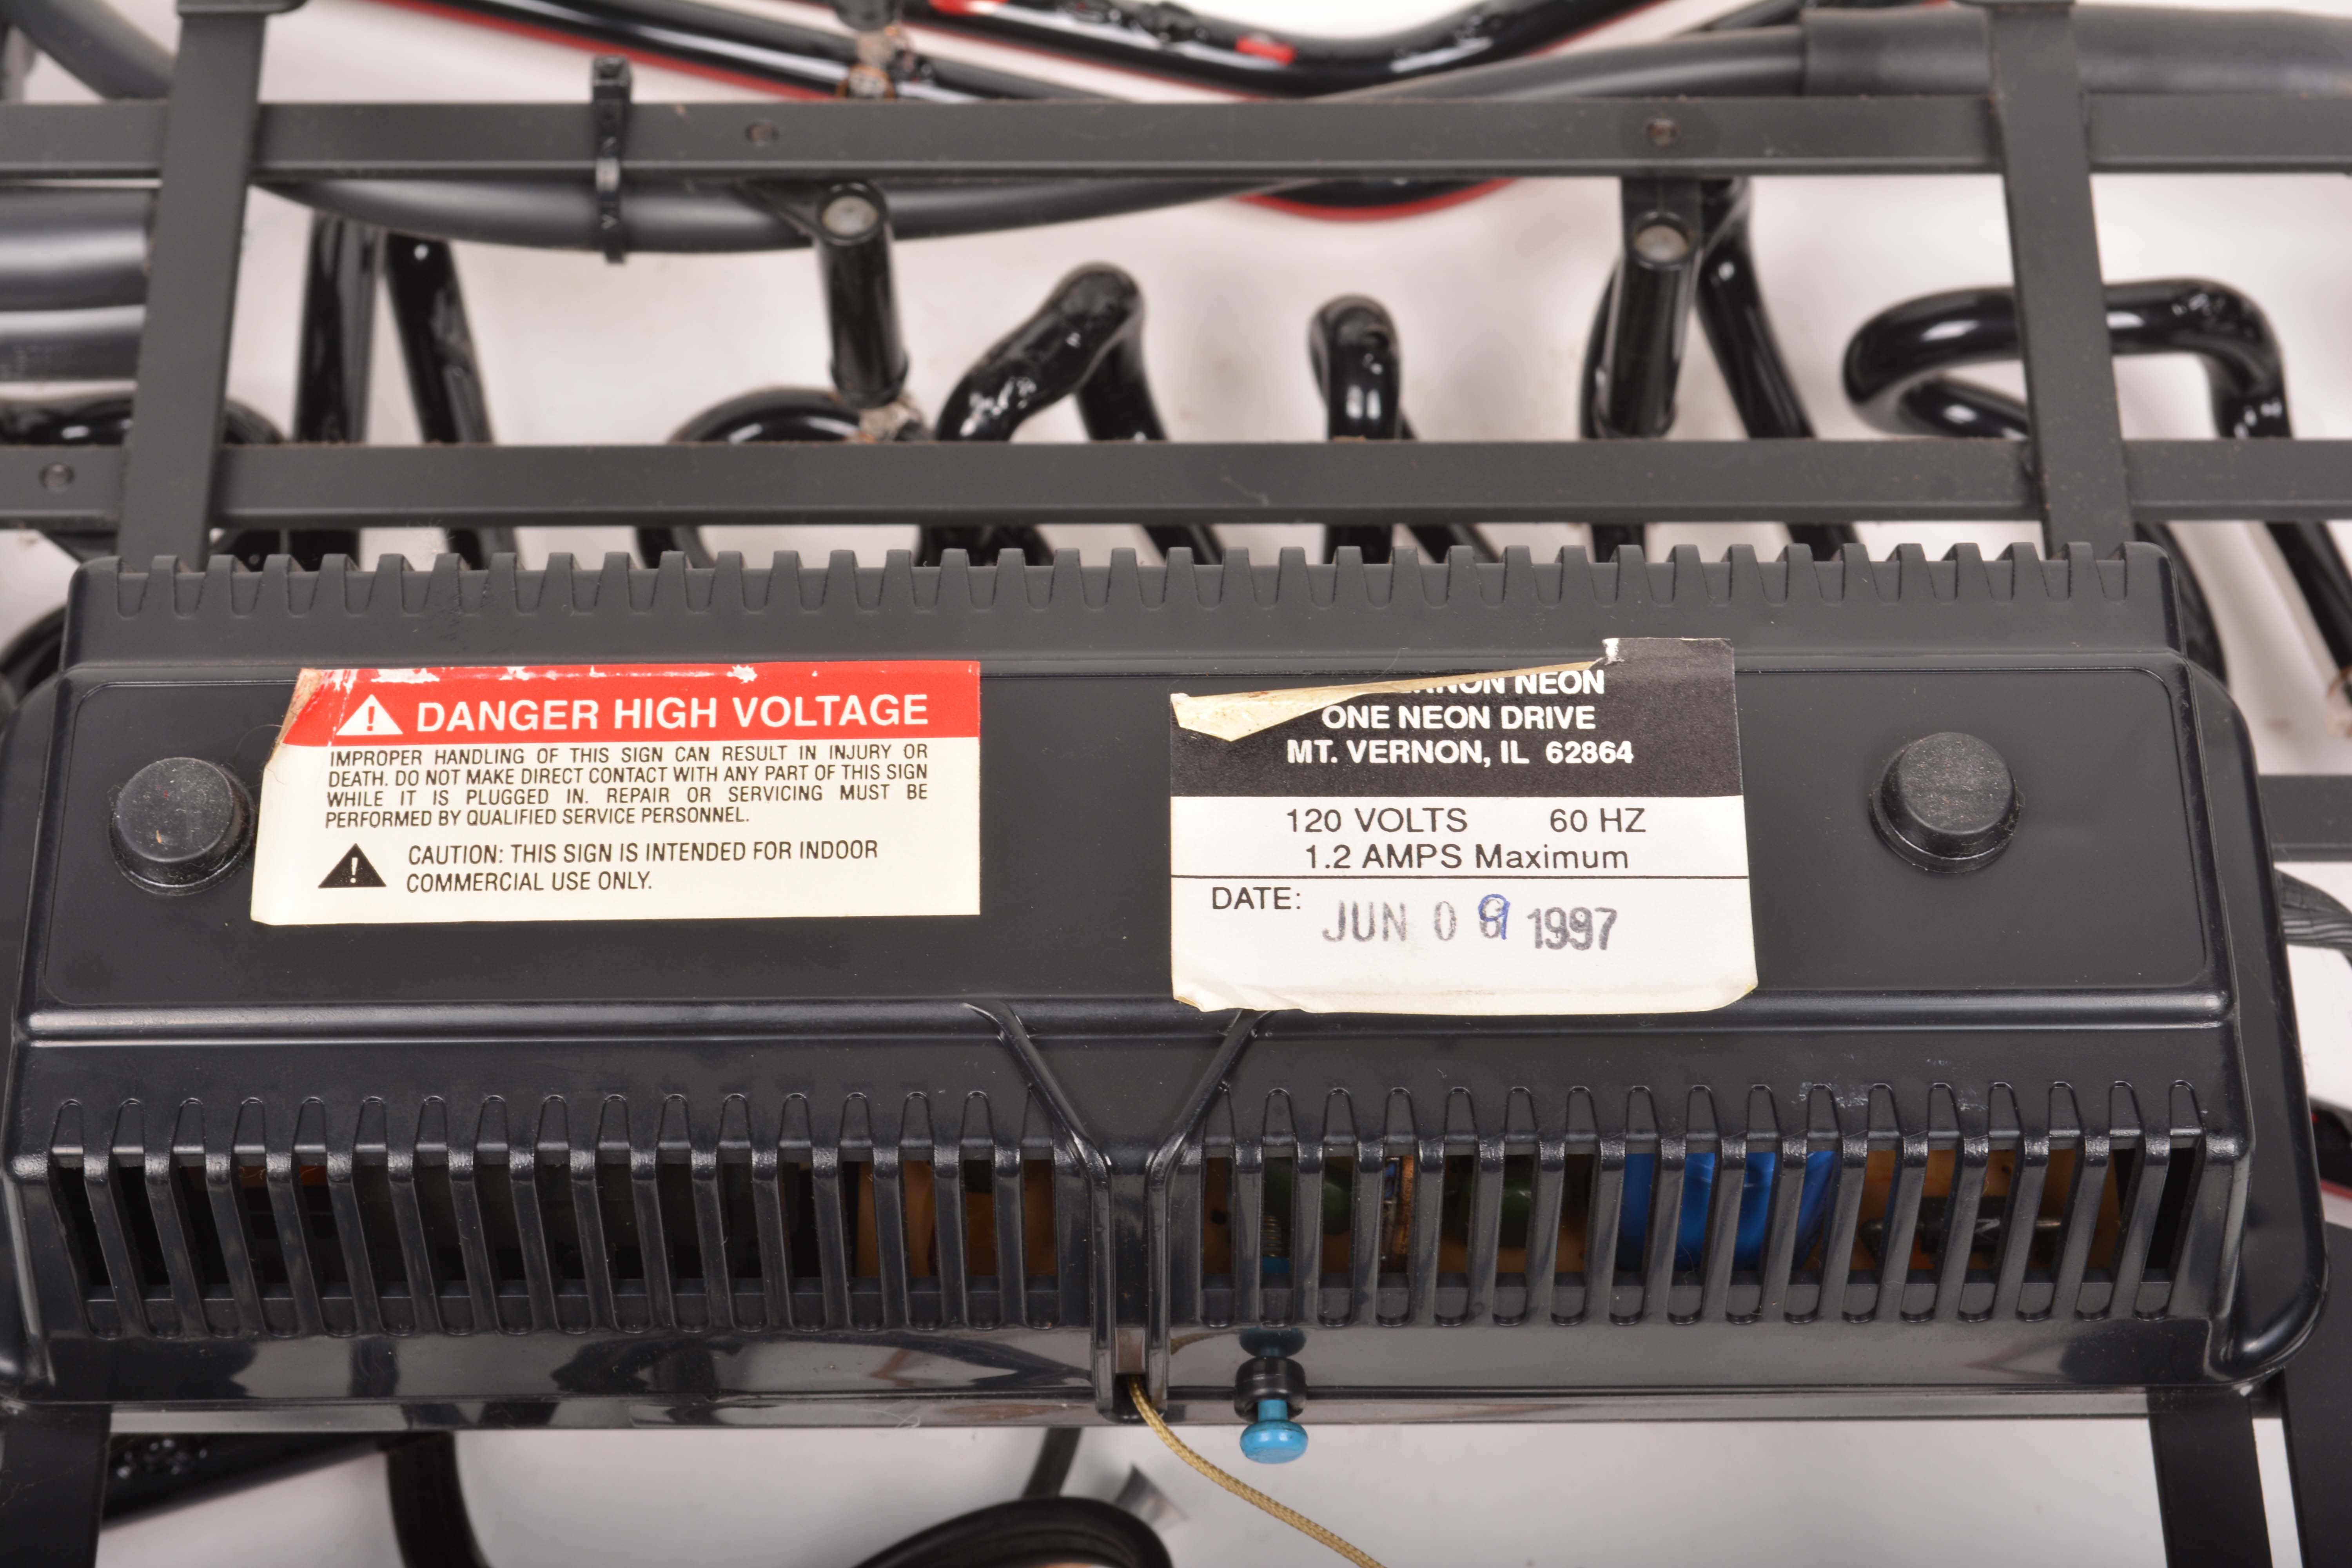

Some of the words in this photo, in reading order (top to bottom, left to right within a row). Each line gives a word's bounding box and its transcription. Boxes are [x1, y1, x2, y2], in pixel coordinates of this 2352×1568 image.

[1514, 670, 1604, 694] NEON
[418, 700, 598, 731] DANGER
[615, 697, 717, 729] HIGH
[733, 694, 928, 727] VOLTAGE
[1322, 706, 1390, 728] ONE
[1399, 706, 1490, 729] NEON
[1501, 706, 1595, 729] DRIVE
[331, 750, 421, 766] IMPROPER
[435, 748, 524, 764] HANDLING
[537, 748, 558, 764] OF
[570, 748, 609, 763] THIS
[622, 747, 662, 762] SIGN
[676, 746, 709, 762] CAN
[723, 745, 788, 761] RESULT
[800, 746, 816, 760] IN
[830, 744, 891, 759] INJURY
[904, 744, 927, 759] OR
[1288, 740, 1337, 763] MT.
[1347, 740, 1490, 767] VERNON,
[1501, 740, 1529, 764] IL
[1546, 741, 1634, 763] 62864
[329, 771, 388, 787] DEATH.
[396, 770, 419, 786] DO
[426, 769, 460, 786] NOT
[466, 769, 514, 784] MAKE
[522, 768, 583, 784] DIRECT
[590, 767, 668, 783] CONTACT
[673, 767, 717, 782] WITH
[724, 766, 758, 781] ANY
[766, 765, 808, 780] PART
[815, 765, 835, 781] OF
[842, 764, 880, 780] THIS
[887, 764, 927, 779] SIGN
[328, 791, 383, 807] WHILE
[401, 790, 416, 806] IT
[433, 790, 448, 806] IS
[466, 789, 548, 805] PLUGGED
[567, 789, 588, 803] IN.
[607, 788, 669, 803] REPAIR
[688, 787, 710, 802] OR
[729, 785, 822, 802] SERVICING
[840, 784, 889, 800] MUST
[907, 784, 927, 800] BE
[326, 811, 432, 828] PERFORMED
[439, 810, 461, 826] BY
[467, 809, 556, 826] QUALIFIED
[563, 808, 635, 824] SERVICE
[642, 807, 749, 823] PERSONNEL.
[1287, 809, 1341, 832] 120
[1355, 808, 1467, 832] VOLTS
[1551, 809, 1587, 832] 60
[1601, 808, 1646, 832] HZ
[409, 845, 503, 865] CAUTION:
[511, 844, 556, 863] THIS
[564, 844, 612, 863] SIGN
[621, 843, 637, 862] IS
[646, 842, 745, 861] INTENDED
[754, 841, 791, 860] FOR
[800, 840, 877, 859] INDOOR
[1307, 844, 1350, 868] 1.2
[1362, 844, 1462, 868] AMPS
[1476, 844, 1628, 868] Maximum
[407, 872, 543, 893] COMMERCIAL
[552, 871, 590, 891] USE
[599, 871, 652, 890] ONLY.
[1213, 887, 1300, 909] DATE:
[1323, 902, 1407, 942] JUN
[1527, 907, 1617, 951] 1997
